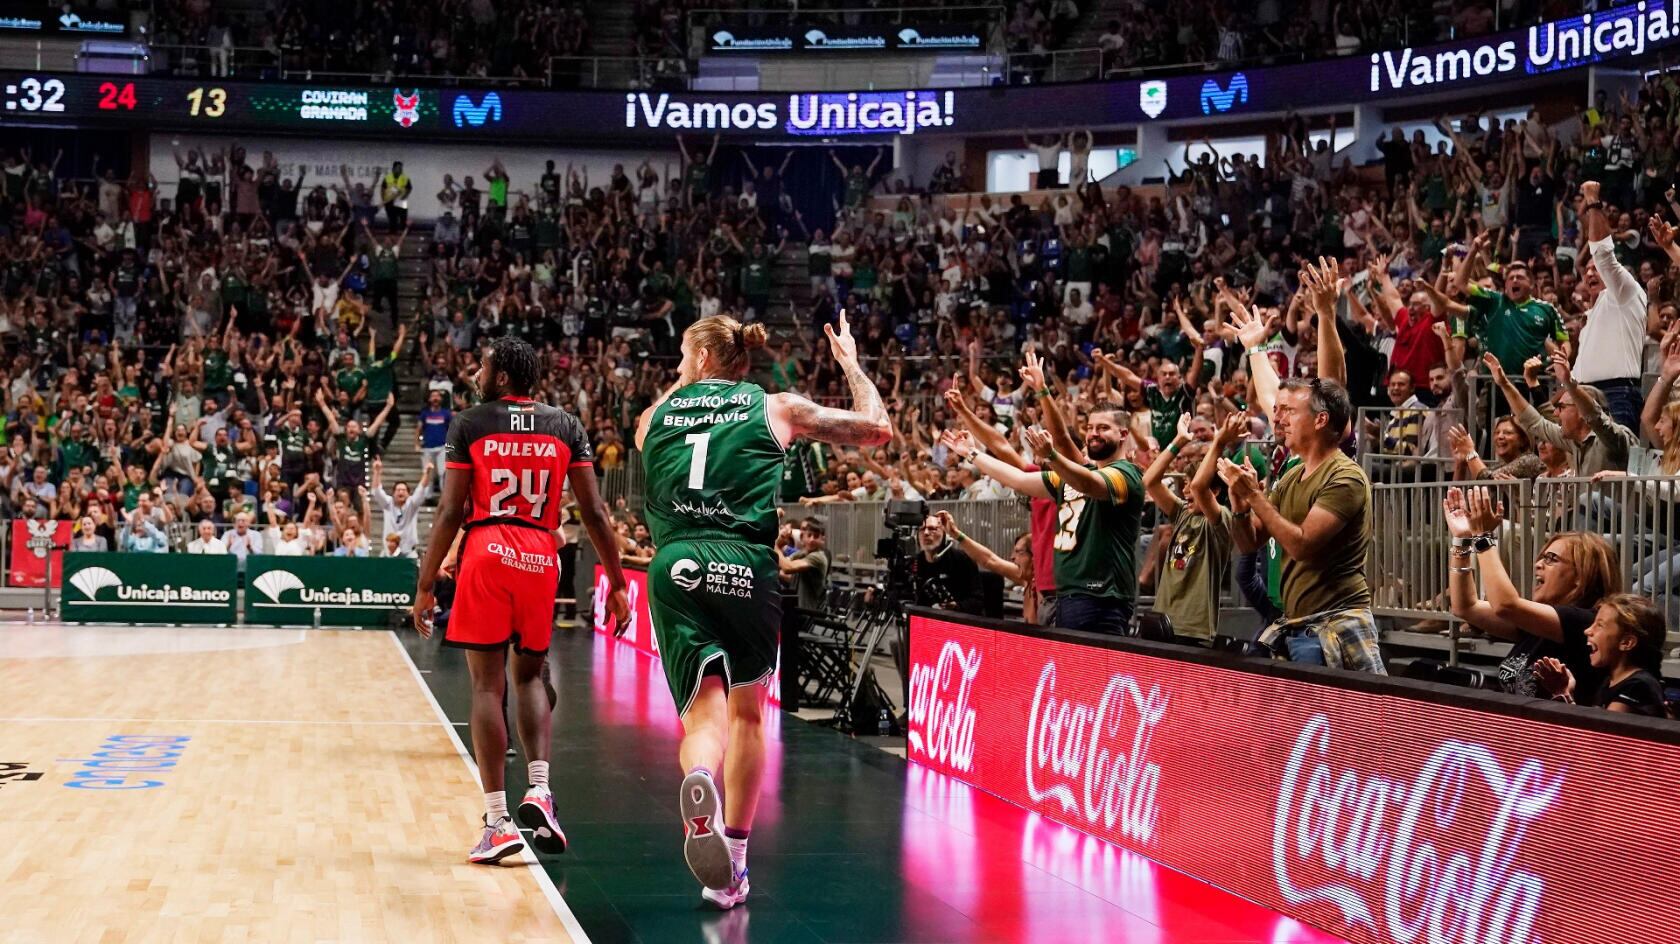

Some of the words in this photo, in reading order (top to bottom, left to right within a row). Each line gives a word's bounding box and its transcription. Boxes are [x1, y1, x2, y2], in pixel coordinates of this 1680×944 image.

[1370, 48, 1516, 92] ¡Vamos
[1529, 0, 1680, 65] Unicaja!
[98, 82, 137, 110] 24
[187, 88, 227, 117] 13
[301, 90, 367, 104] COVIRAN
[300, 105, 367, 120] GRANADA
[626, 93, 777, 129] ¡Vamos
[790, 91, 954, 135] Unicaja!
[510, 414, 535, 431] ALI
[484, 440, 557, 458] PULEVA
[684, 432, 711, 490] 1
[490, 469, 550, 518] 24
[487, 543, 517, 559] CAJA
[520, 552, 554, 567] RURA
[501, 557, 545, 573] GRANADA
[708, 561, 754, 579] COSTA
[706, 573, 729, 584] DEL
[731, 576, 754, 589] SOL
[117, 584, 179, 603] Unicaja
[180, 586, 230, 601] Banco
[300, 587, 360, 606] Unicaja
[361, 589, 411, 604] Banco
[706, 583, 752, 599] MÁLAGA
